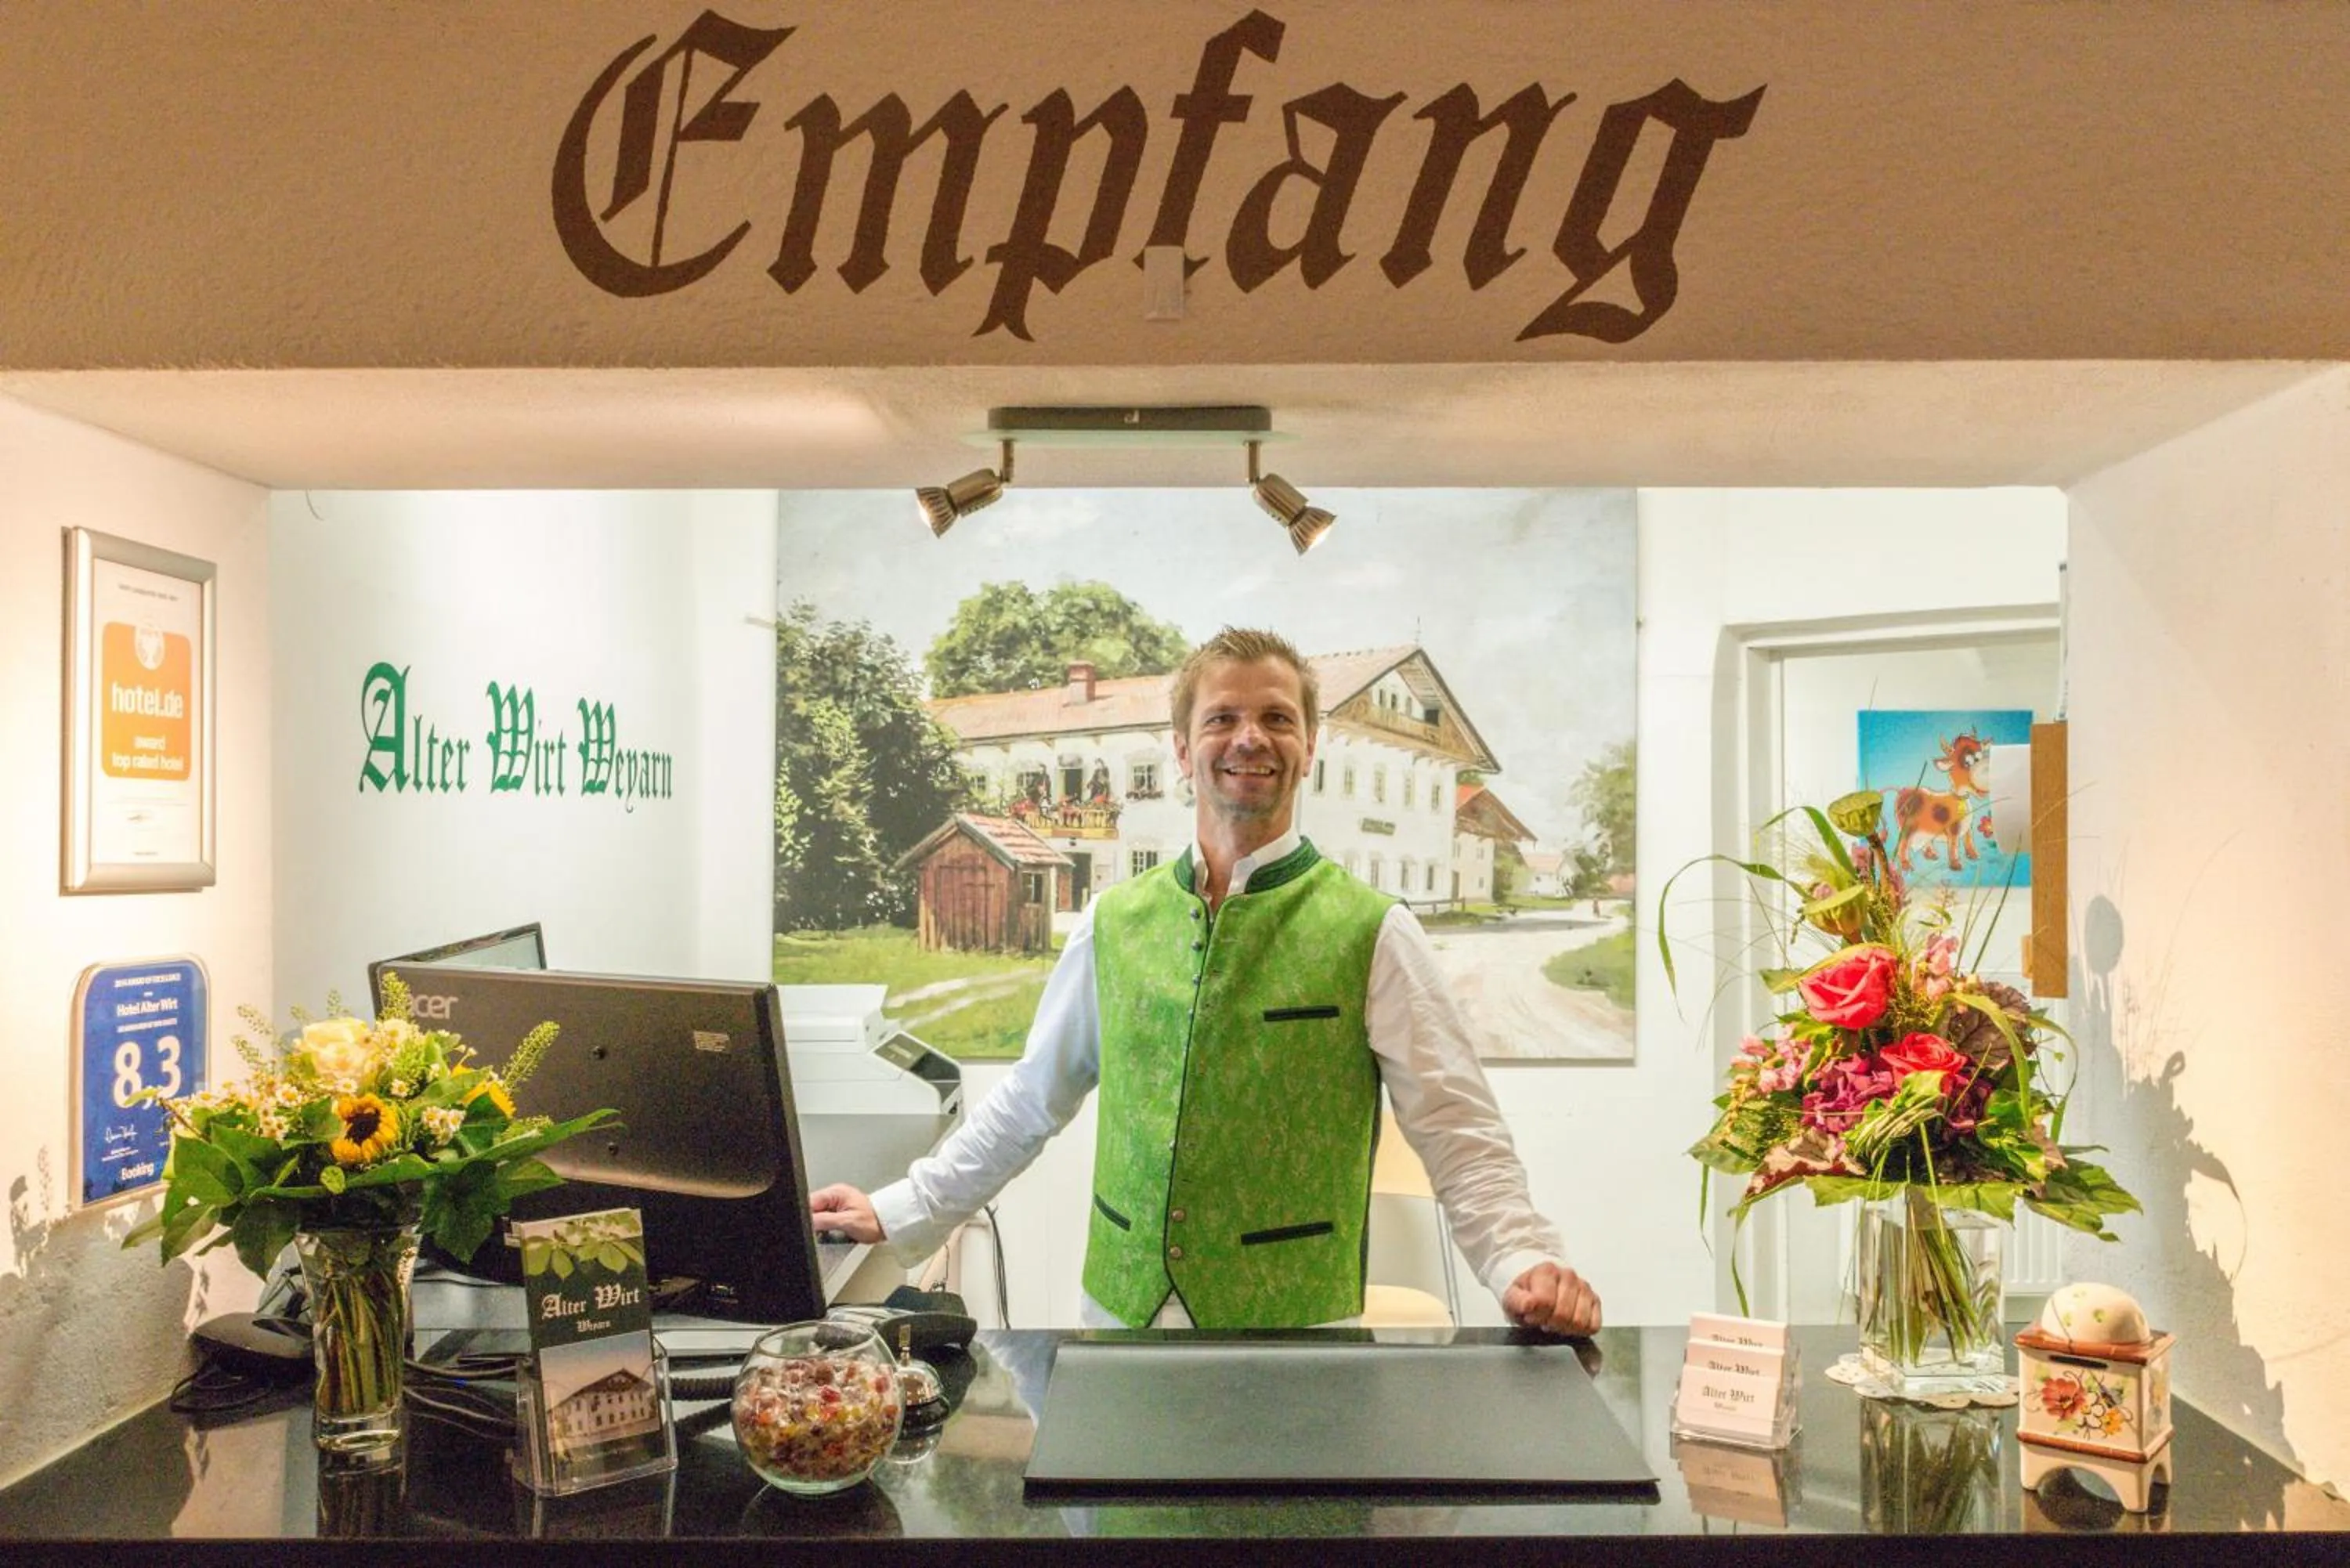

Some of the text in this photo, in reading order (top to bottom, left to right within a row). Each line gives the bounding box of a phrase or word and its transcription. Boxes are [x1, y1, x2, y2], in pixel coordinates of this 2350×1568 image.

[551, 7, 1769, 345] Empfang
[111, 680, 184, 719] hotel.de
[358, 661, 673, 814] Alter Wirt Weyarn
[117, 997, 179, 1017] Hotel Alter Wirt
[398, 993, 459, 1020] cer
[541, 1282, 641, 1321] Alter Wirt
